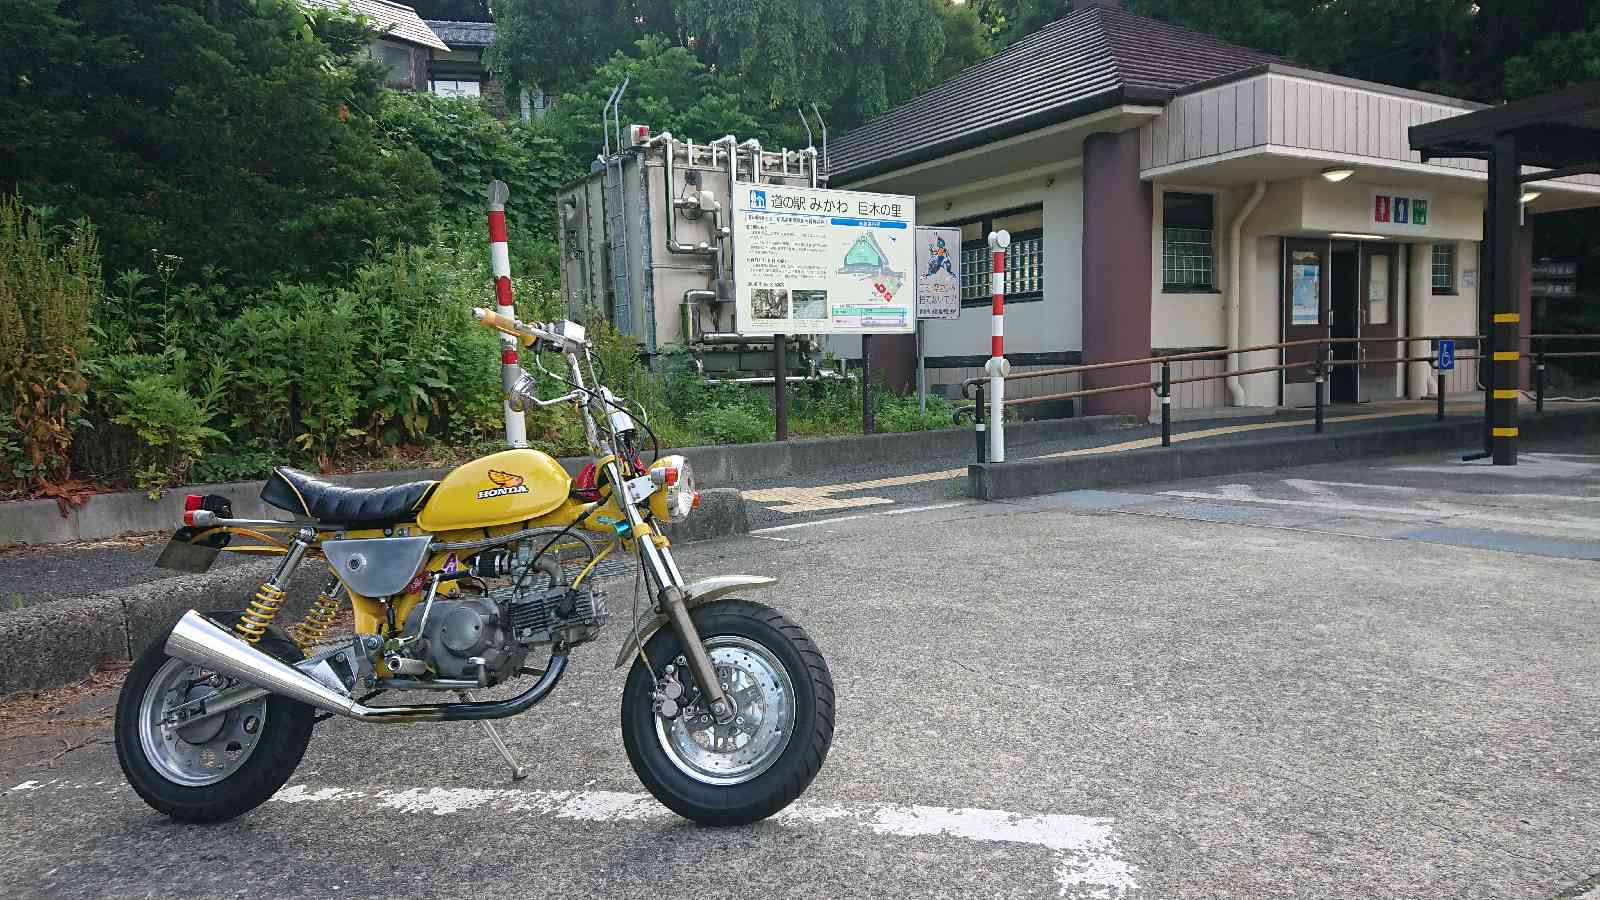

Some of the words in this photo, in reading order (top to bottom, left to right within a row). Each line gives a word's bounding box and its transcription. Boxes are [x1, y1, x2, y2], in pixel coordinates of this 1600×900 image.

[771, 194, 806, 211] 道の駅
[810, 199, 849, 214] みかわ
[858, 201, 902, 217] 巨木の里
[477, 485, 529, 499] HONDA
